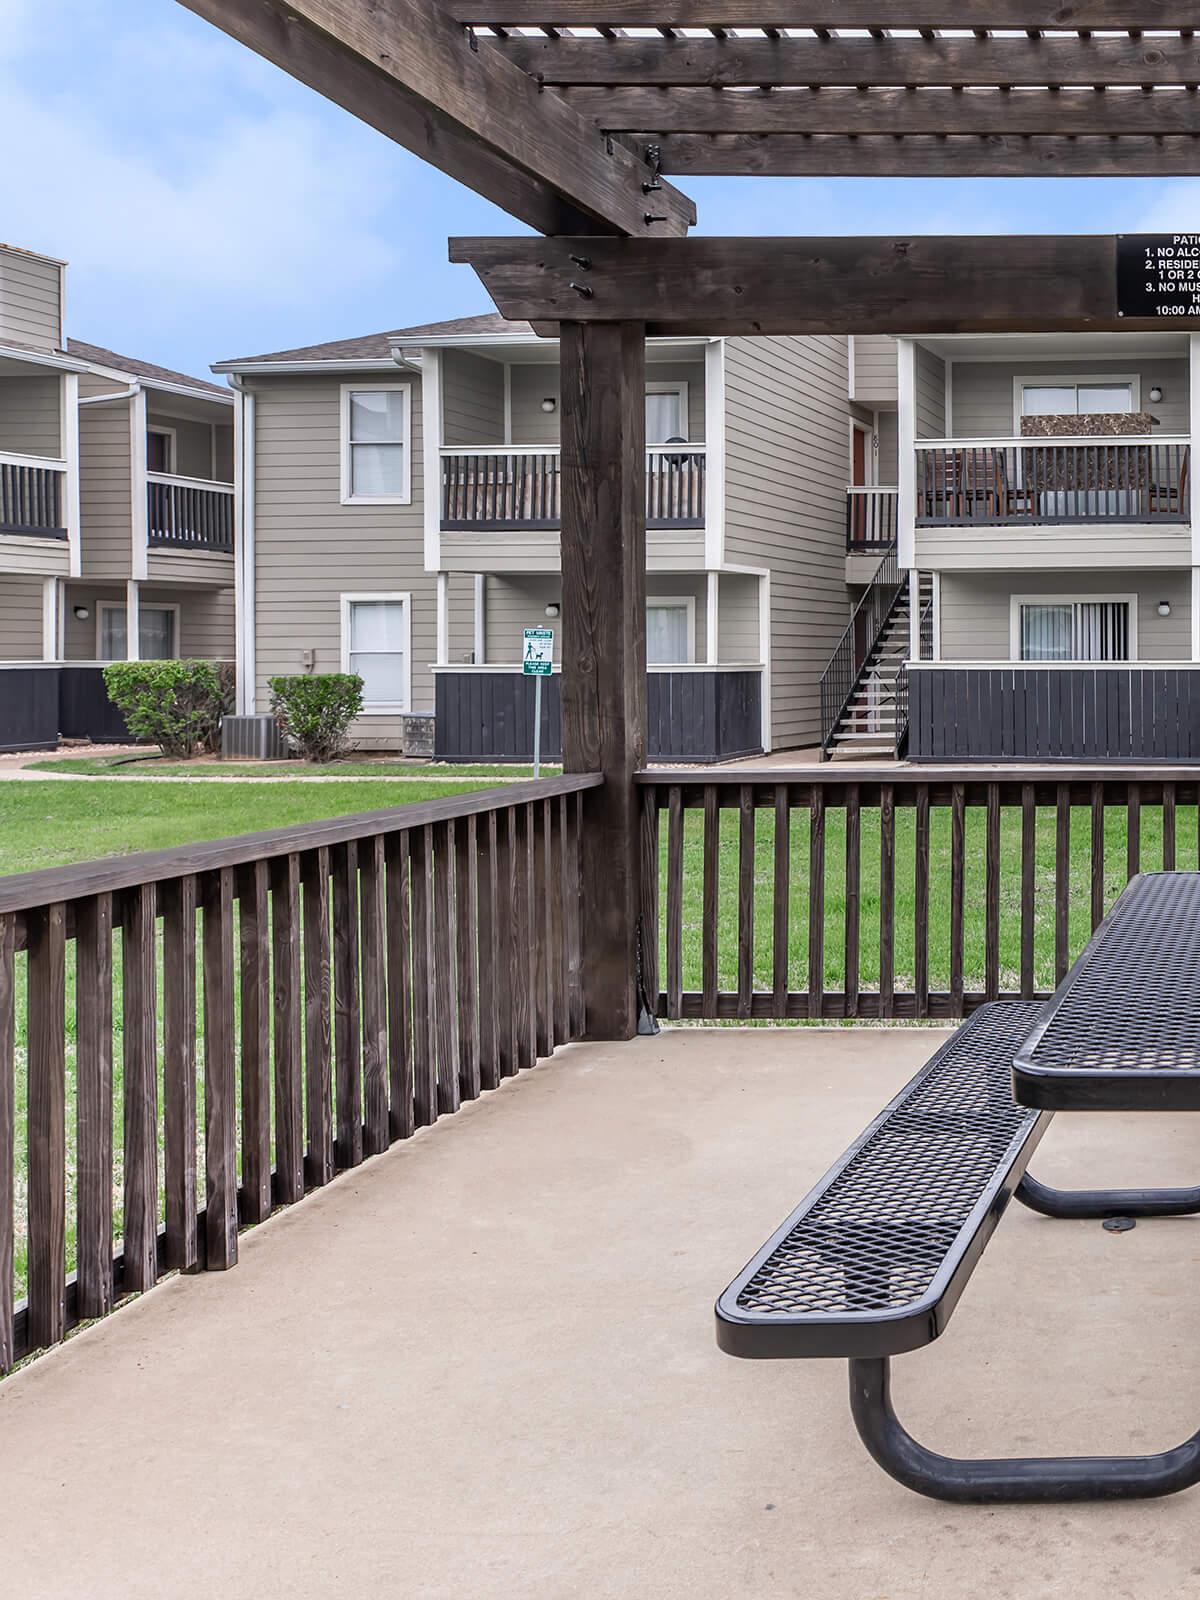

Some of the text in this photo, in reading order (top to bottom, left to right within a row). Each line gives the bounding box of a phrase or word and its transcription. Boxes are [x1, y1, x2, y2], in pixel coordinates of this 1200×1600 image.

[1145, 248, 1155, 257] 1.
[1157, 247, 1174, 257] NO
[1145, 260, 1156, 269] 2.
[1158, 270, 1164, 279] 1
[1168, 270, 1184, 280] OR
[1186, 270, 1195, 279] 2
[1145, 282, 1156, 292] 3.
[1158, 282, 1176, 292] NO
[1155, 305, 1186, 315] 10:00
